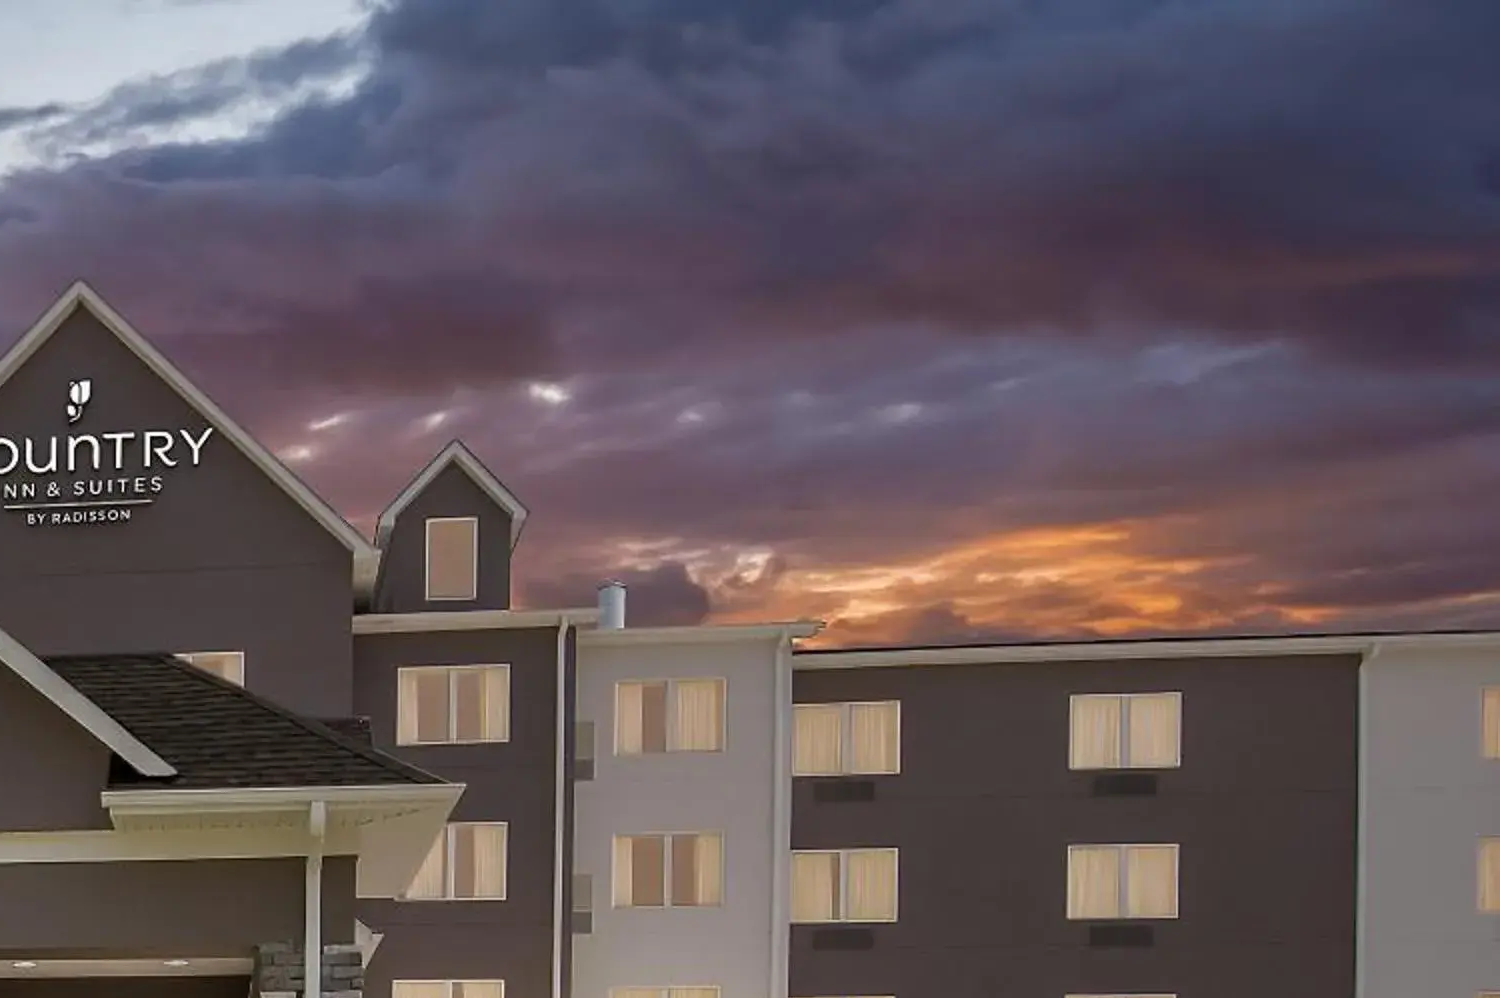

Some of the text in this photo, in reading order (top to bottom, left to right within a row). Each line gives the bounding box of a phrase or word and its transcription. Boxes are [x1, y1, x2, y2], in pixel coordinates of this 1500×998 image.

[46, 481, 61, 497] &
[73, 475, 164, 497] SUITES
[27, 509, 132, 525] BY RADISSON
